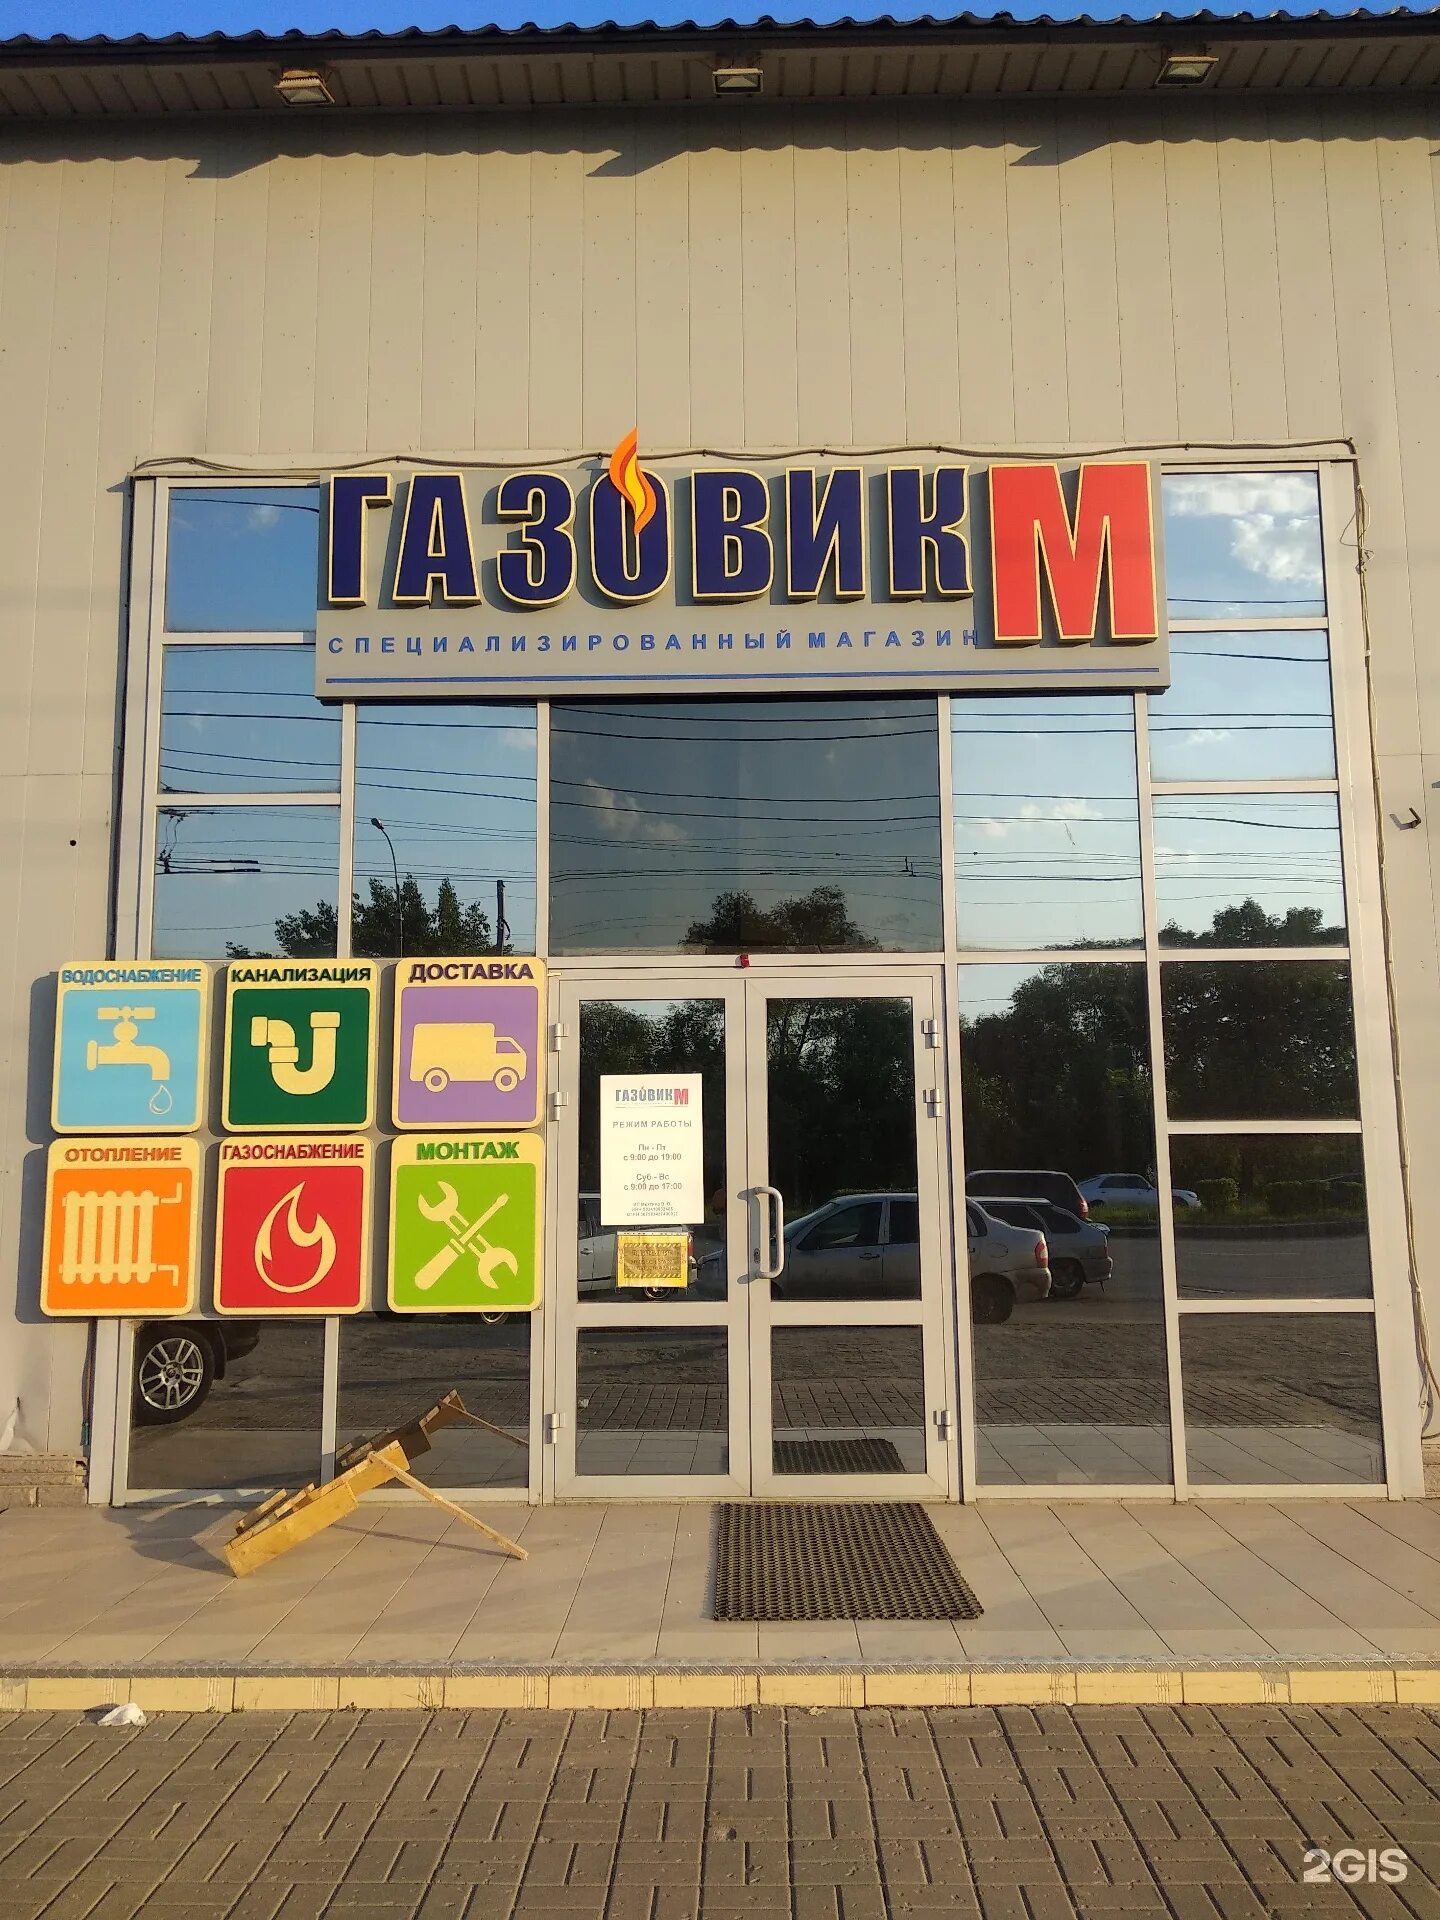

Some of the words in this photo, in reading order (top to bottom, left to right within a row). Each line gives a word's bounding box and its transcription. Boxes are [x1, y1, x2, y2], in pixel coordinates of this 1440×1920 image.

[328, 629, 793, 655] СПЕЦИАЛИЗИРОВАННЫЙ
[808, 629, 978, 649] МАГАЗИН
[61, 968, 201, 984] ВОДОСНАБЖЕНИЕ
[231, 967, 371, 984] КАНАЛИЗАЦИЯ
[408, 963, 534, 983] ДОСТАВКА
[612, 1121, 648, 1129] РЕЖИМ
[651, 1120, 692, 1128] РАБОТЫ
[64, 1147, 182, 1163] ОТОПЛЕНИЕ
[222, 1143, 365, 1161] ГАЗОСНАБЖЕНИЕ
[416, 1141, 520, 1160] МОНТАЖ
[630, 1153, 647, 1161] 9:00
[648, 1154, 659, 1162] до
[661, 1153, 682, 1161] 19:00
[636, 1173, 652, 1182] Суб
[630, 1183, 647, 1191] 9:00
[661, 1182, 682, 1190] 17:00
